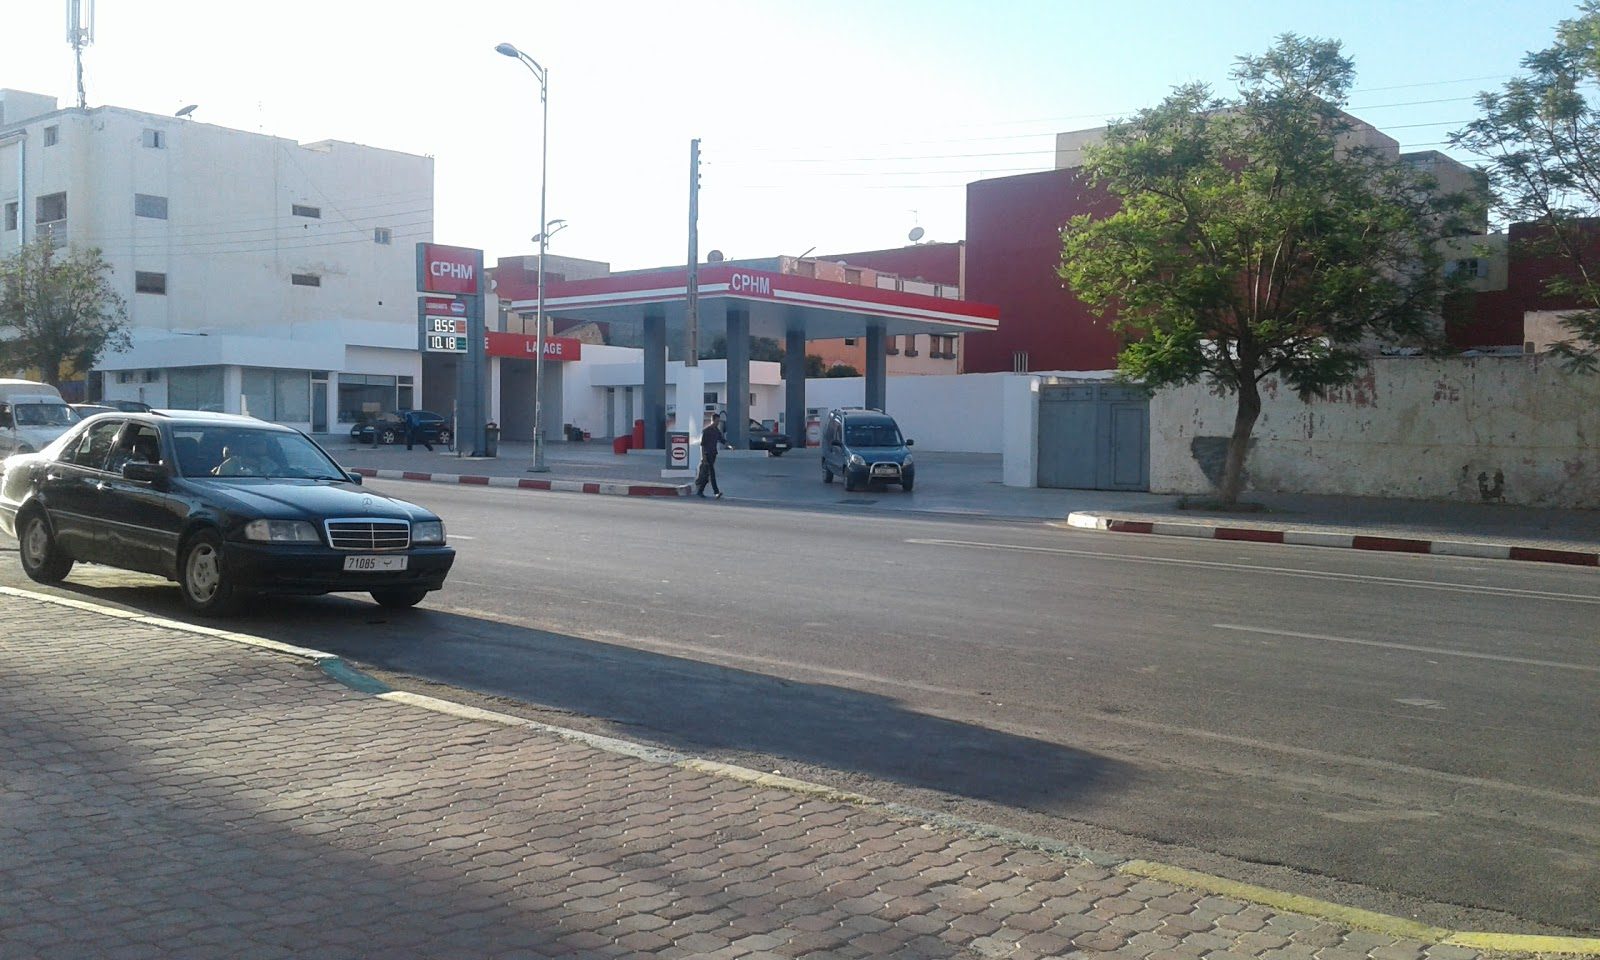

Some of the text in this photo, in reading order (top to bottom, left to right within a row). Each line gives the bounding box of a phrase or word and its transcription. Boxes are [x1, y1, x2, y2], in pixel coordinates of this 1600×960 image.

[430, 261, 473, 280] CPHM
[732, 273, 770, 295] CPHM
[526, 341, 562, 355] LAAGE
[348, 557, 375, 569] 71085
